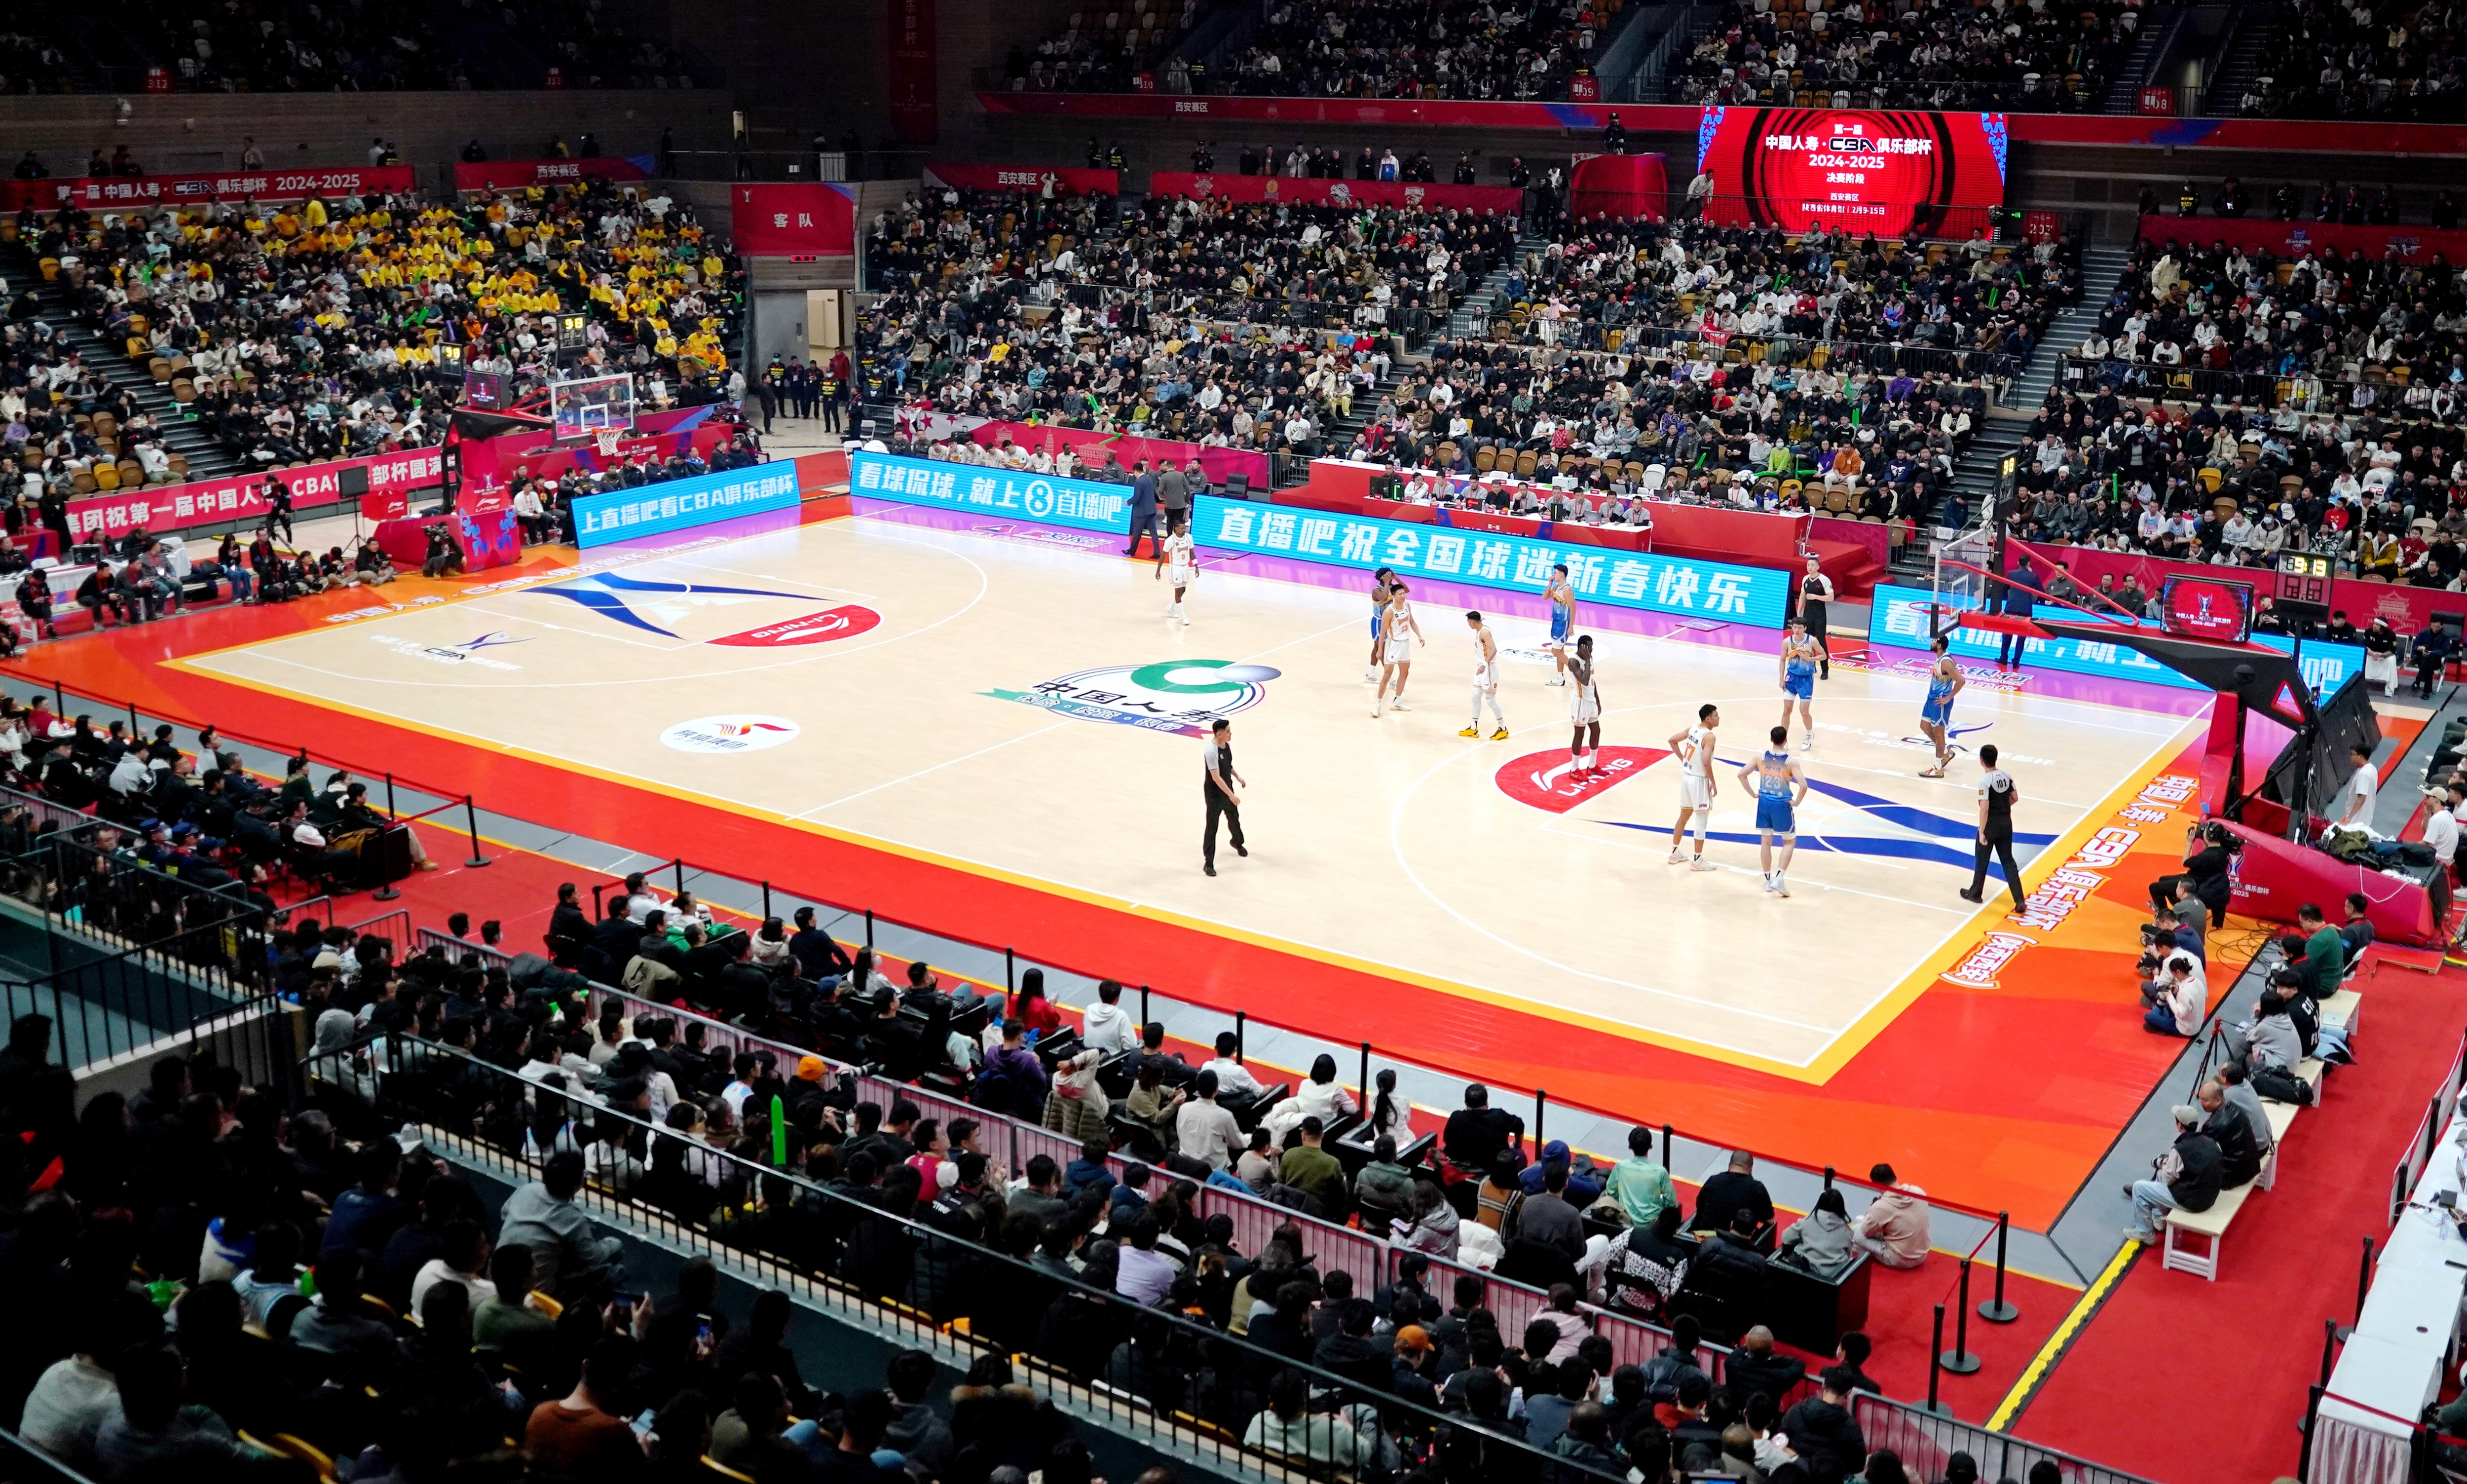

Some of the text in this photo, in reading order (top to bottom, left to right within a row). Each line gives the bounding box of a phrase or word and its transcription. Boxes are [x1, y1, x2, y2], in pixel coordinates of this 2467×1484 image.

[1175, 102, 1208, 112] 西安赛区
[1834, 123, 1863, 135] 第一届
[1809, 154, 1885, 169] 2024-2025
[536, 163, 581, 178] 西安赛区
[998, 172, 1038, 186] 西安赛区
[1826, 172, 1865, 185] 决赛阶段
[57, 185, 100, 201] 第一届
[275, 173, 361, 191] 2024-2025
[1830, 193, 1859, 202] 西安赛区
[773, 212, 814, 228] 客队
[581, 473, 794, 534] 上直播吧看CBA俱乐部杯
[1217, 507, 1753, 614] 直播吧祝全国球迷新春快乐
[750, 613, 839, 638] LI-NING
[1683, 742, 1696, 761] 17
[1763, 774, 1781, 789] 23
[1996, 778, 2008, 789] 101
